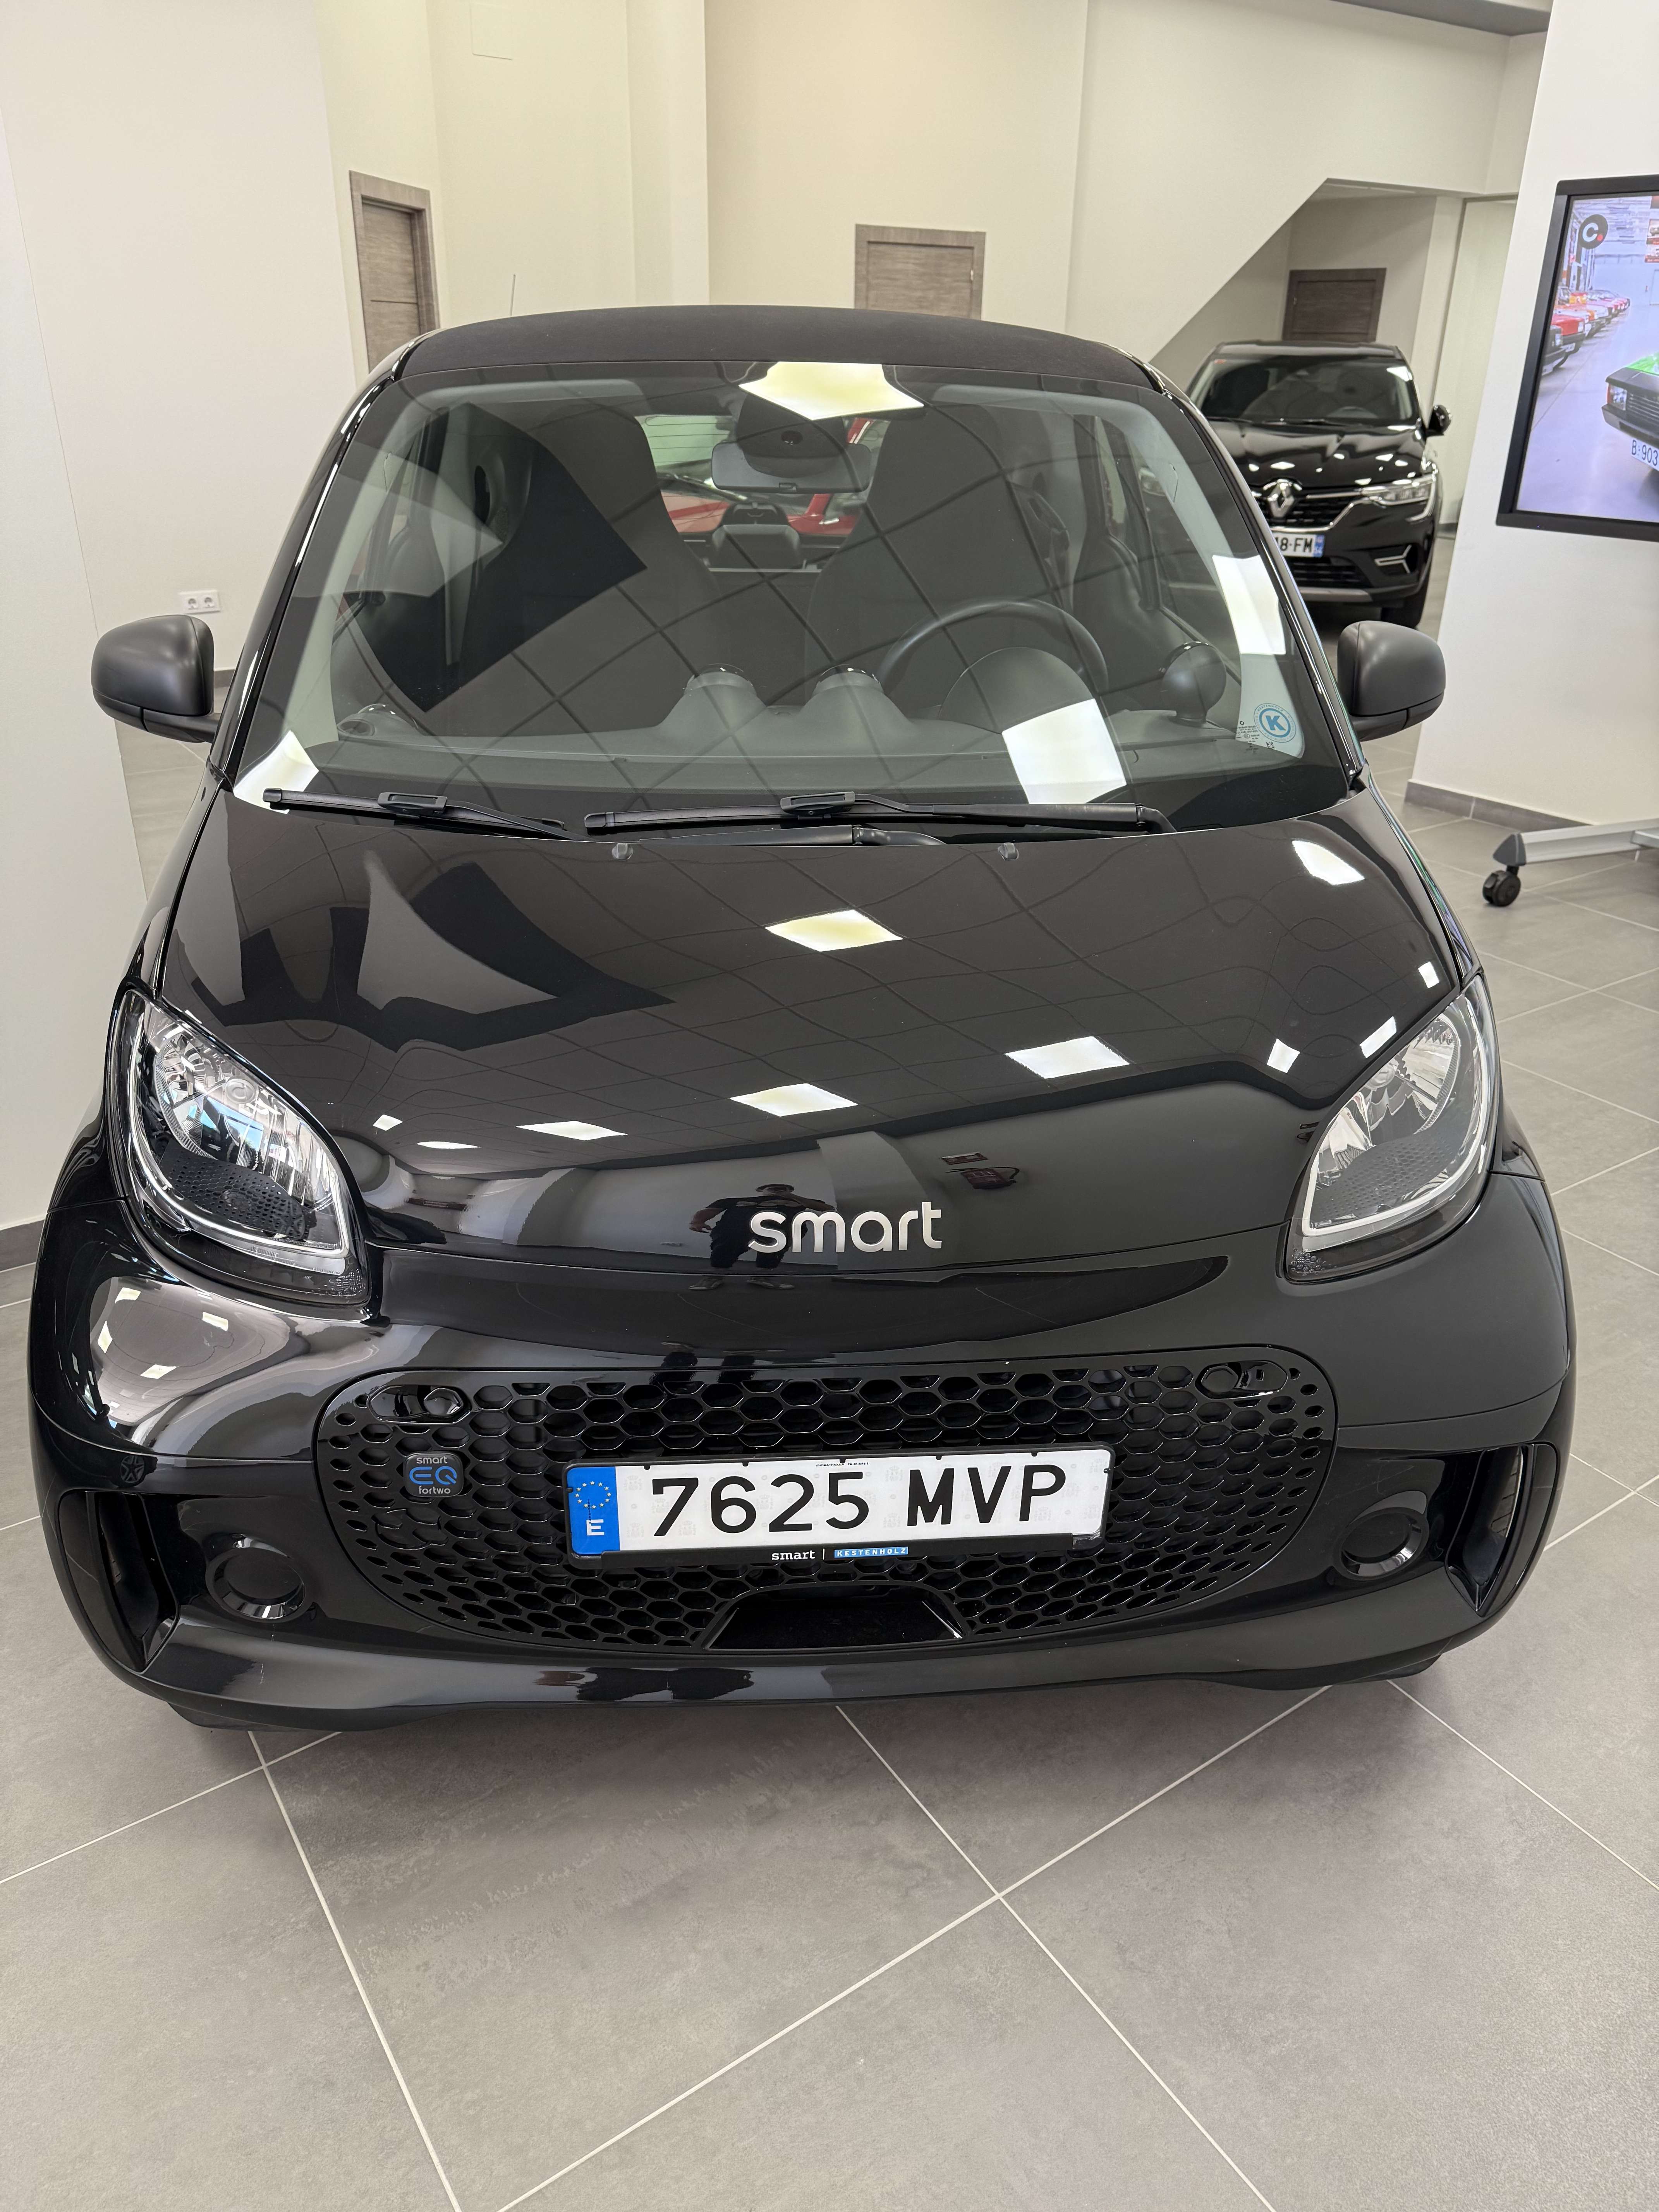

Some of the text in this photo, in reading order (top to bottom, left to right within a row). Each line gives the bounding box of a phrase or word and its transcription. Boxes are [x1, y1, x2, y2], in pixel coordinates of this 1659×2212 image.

[1265, 715, 1286, 731] K
[749, 1202, 942, 1253] smart
[409, 1466, 457, 1485] EQ
[419, 1486, 451, 1494] fortwo
[586, 1519, 605, 1536] E
[653, 1472, 869, 1536] 7625
[907, 1465, 1066, 1527] MVP
[772, 1548, 907, 1560] smart KESTENHOLZ
